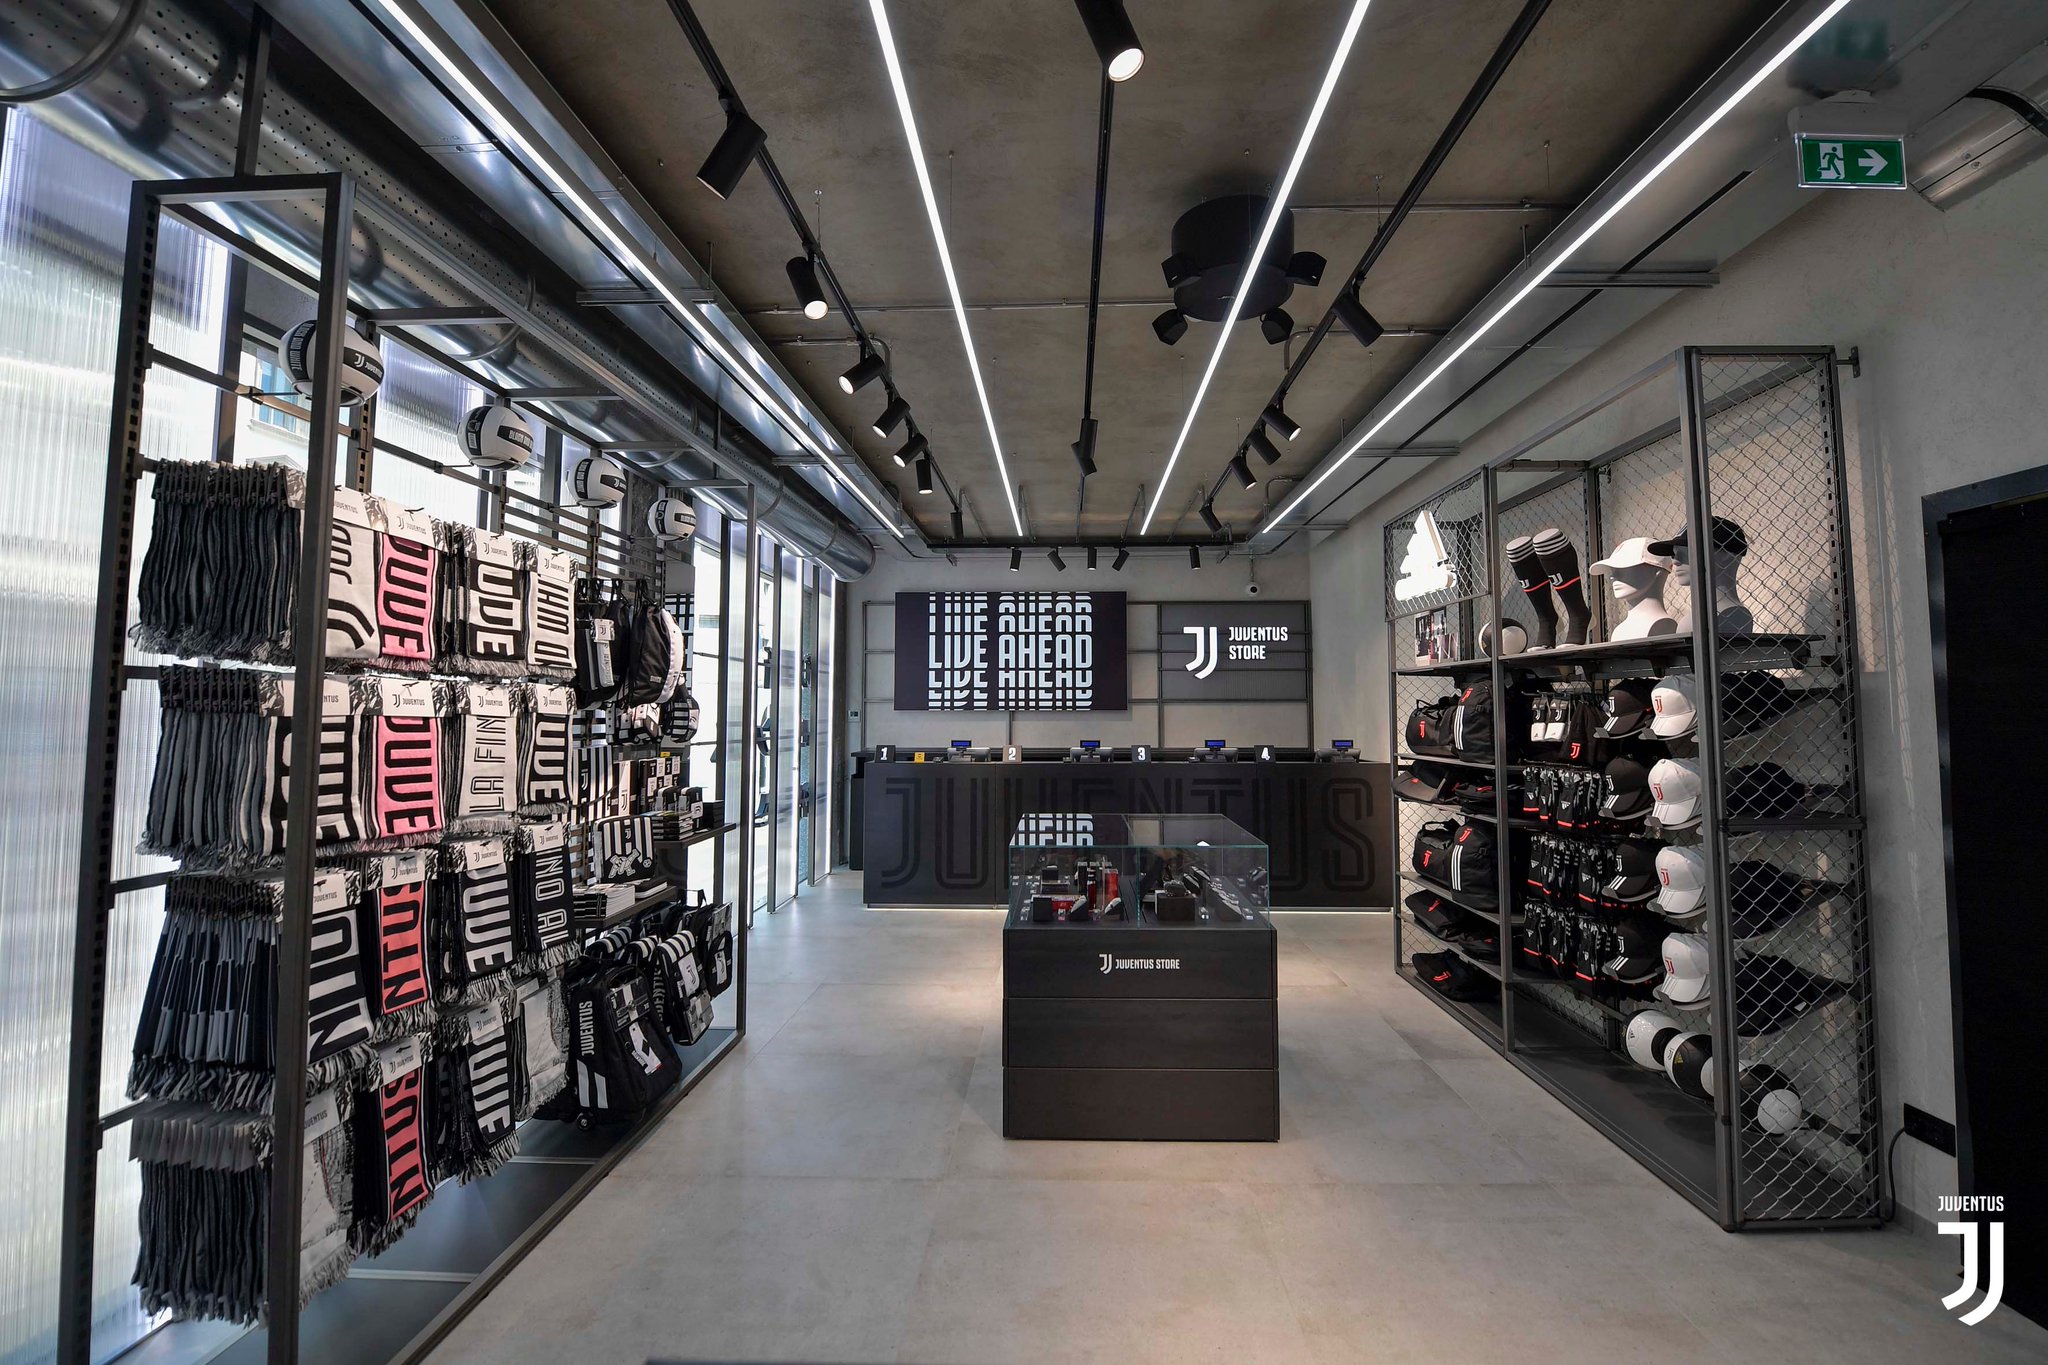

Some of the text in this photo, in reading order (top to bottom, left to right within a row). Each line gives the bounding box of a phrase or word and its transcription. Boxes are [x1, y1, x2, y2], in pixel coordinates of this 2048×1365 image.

[289, 350, 302, 371] WHITE
[406, 523, 427, 535] JUVENTUS
[1229, 626, 1288, 641] JUVENTUS
[929, 634, 1092, 669] LIVE AHEAD
[1229, 645, 1266, 660] STORE
[402, 697, 425, 706] JUVENTUS
[880, 746, 888, 761] 1
[1008, 747, 1016, 761] 2
[1137, 747, 1146, 761] 3
[1261, 747, 1270, 761] 4
[1115, 959, 1181, 970] JUVENTUS STORE
[578, 1000, 595, 1056] JUVENTUS
